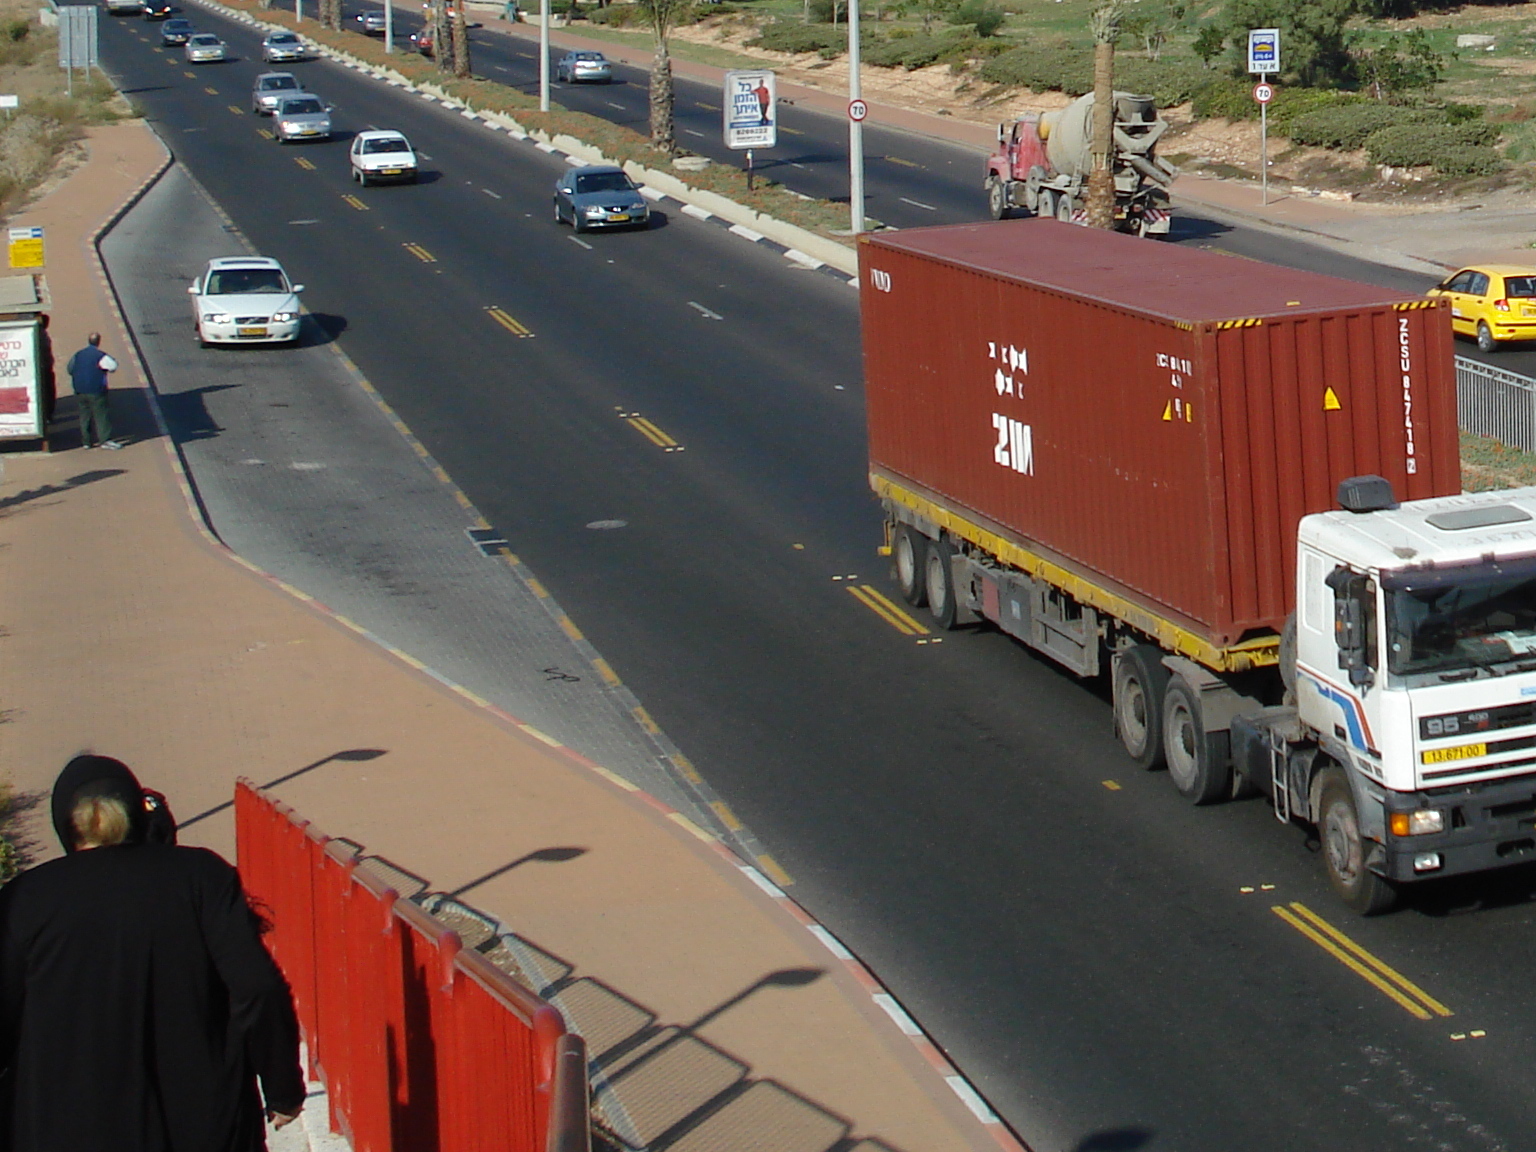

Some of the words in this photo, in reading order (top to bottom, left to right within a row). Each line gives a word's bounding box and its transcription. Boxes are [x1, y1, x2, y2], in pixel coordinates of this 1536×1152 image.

[738, 81, 751, 92] כל
[734, 93, 757, 104] הזמן
[852, 106, 864, 115] 70
[1398, 318, 1410, 372] ZCSU
[1403, 375, 1414, 455] 847418
[1426, 716, 1460, 735] 95
